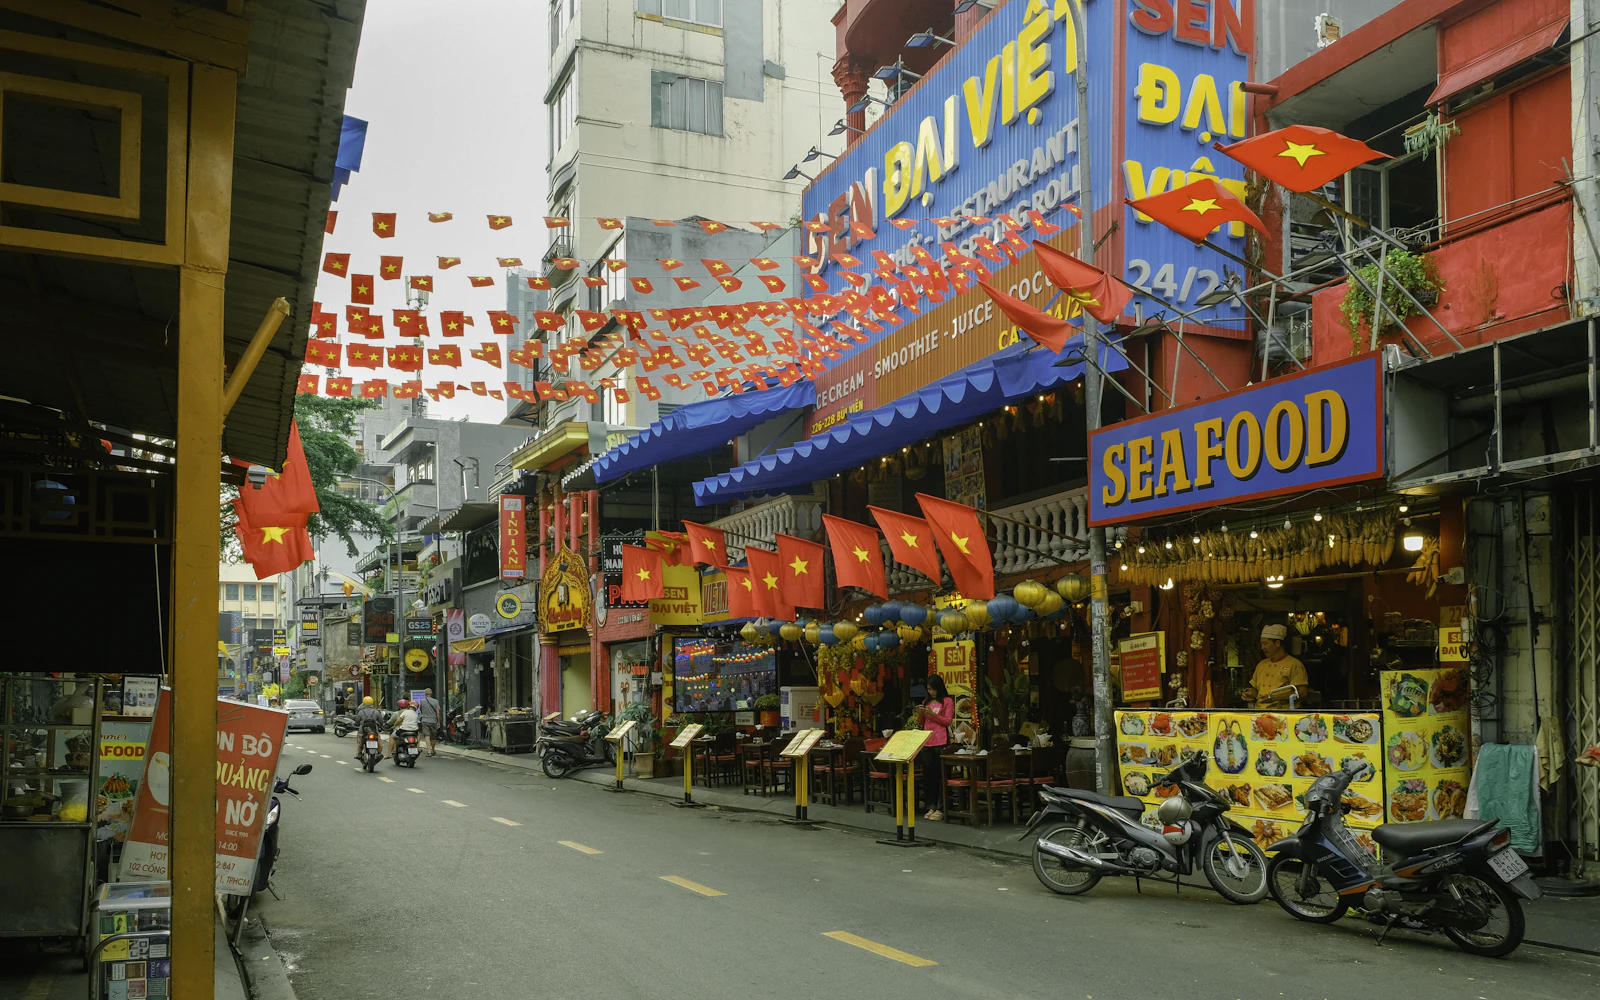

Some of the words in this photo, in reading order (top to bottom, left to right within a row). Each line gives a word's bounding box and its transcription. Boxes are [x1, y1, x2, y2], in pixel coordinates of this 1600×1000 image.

[1130, 0, 1253, 57] SEN
[1134, 62, 1246, 144] ĐẠI
[806, 167, 879, 276] SEN
[883, 94, 960, 219] ĐẠI
[937, 117, 1079, 244] RESTAURANT
[828, 370, 865, 403] CREAM
[874, 328, 939, 380] SMOOTHIE
[951, 298, 994, 340] JUICE
[811, 413, 836, 435] 226-228
[1102, 389, 1349, 507] SEAFOOD
[508, 511, 519, 564] INDIAN
[652, 603, 671, 616] ĐẠI
[673, 602, 698, 616] VIỆT
[408, 621, 431, 630] GS25
[947, 649, 963, 664] SEN
[1442, 646, 1458, 657] ĐẠI
[241, 732, 273, 758] BÒ
[225, 792, 259, 827] NỞ
[218, 841, 238, 851] 14:00
[129, 862, 141, 871] 102
[1502, 860, 1524, 878] 3905
[226, 876, 251, 887] TPHCM
